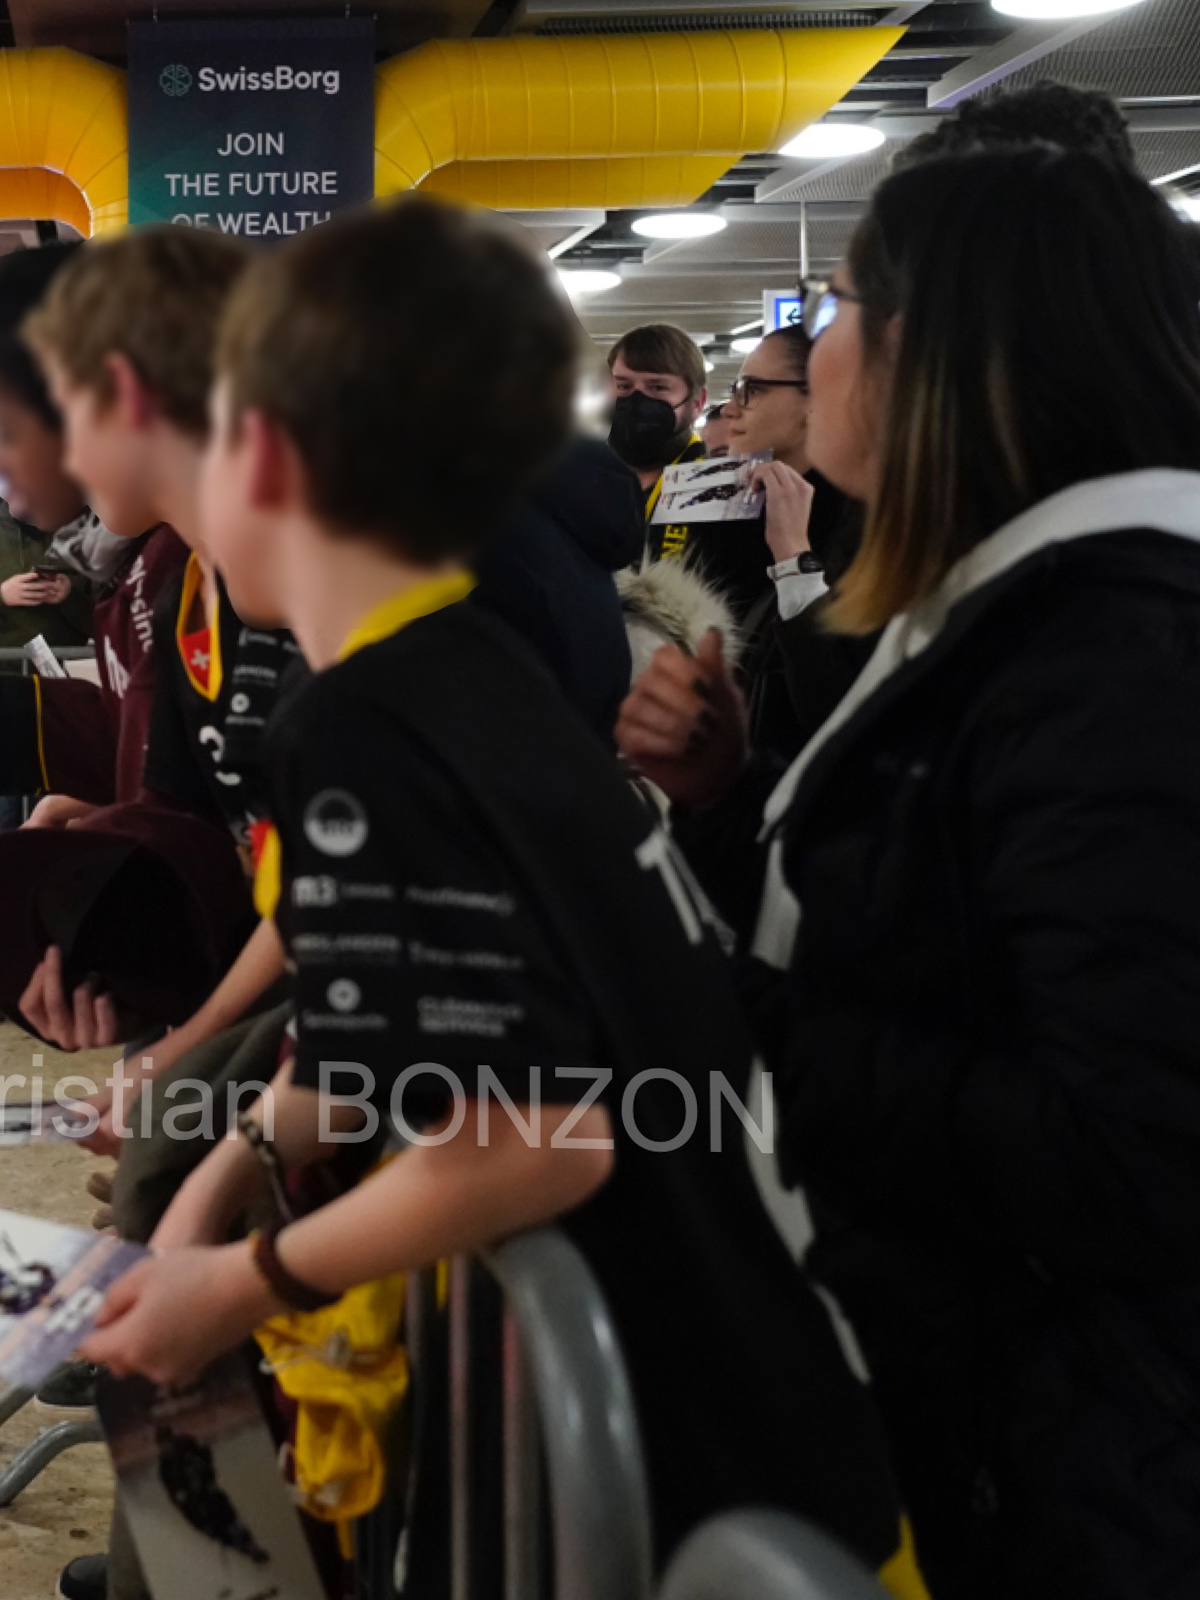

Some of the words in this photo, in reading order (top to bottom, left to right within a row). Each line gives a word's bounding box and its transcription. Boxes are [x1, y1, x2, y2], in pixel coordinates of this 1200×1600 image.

[198, 66, 340, 95] SwissBorg
[217, 133, 285, 156] JOIN
[164, 173, 220, 197] THE
[228, 171, 339, 196] FUTURE
